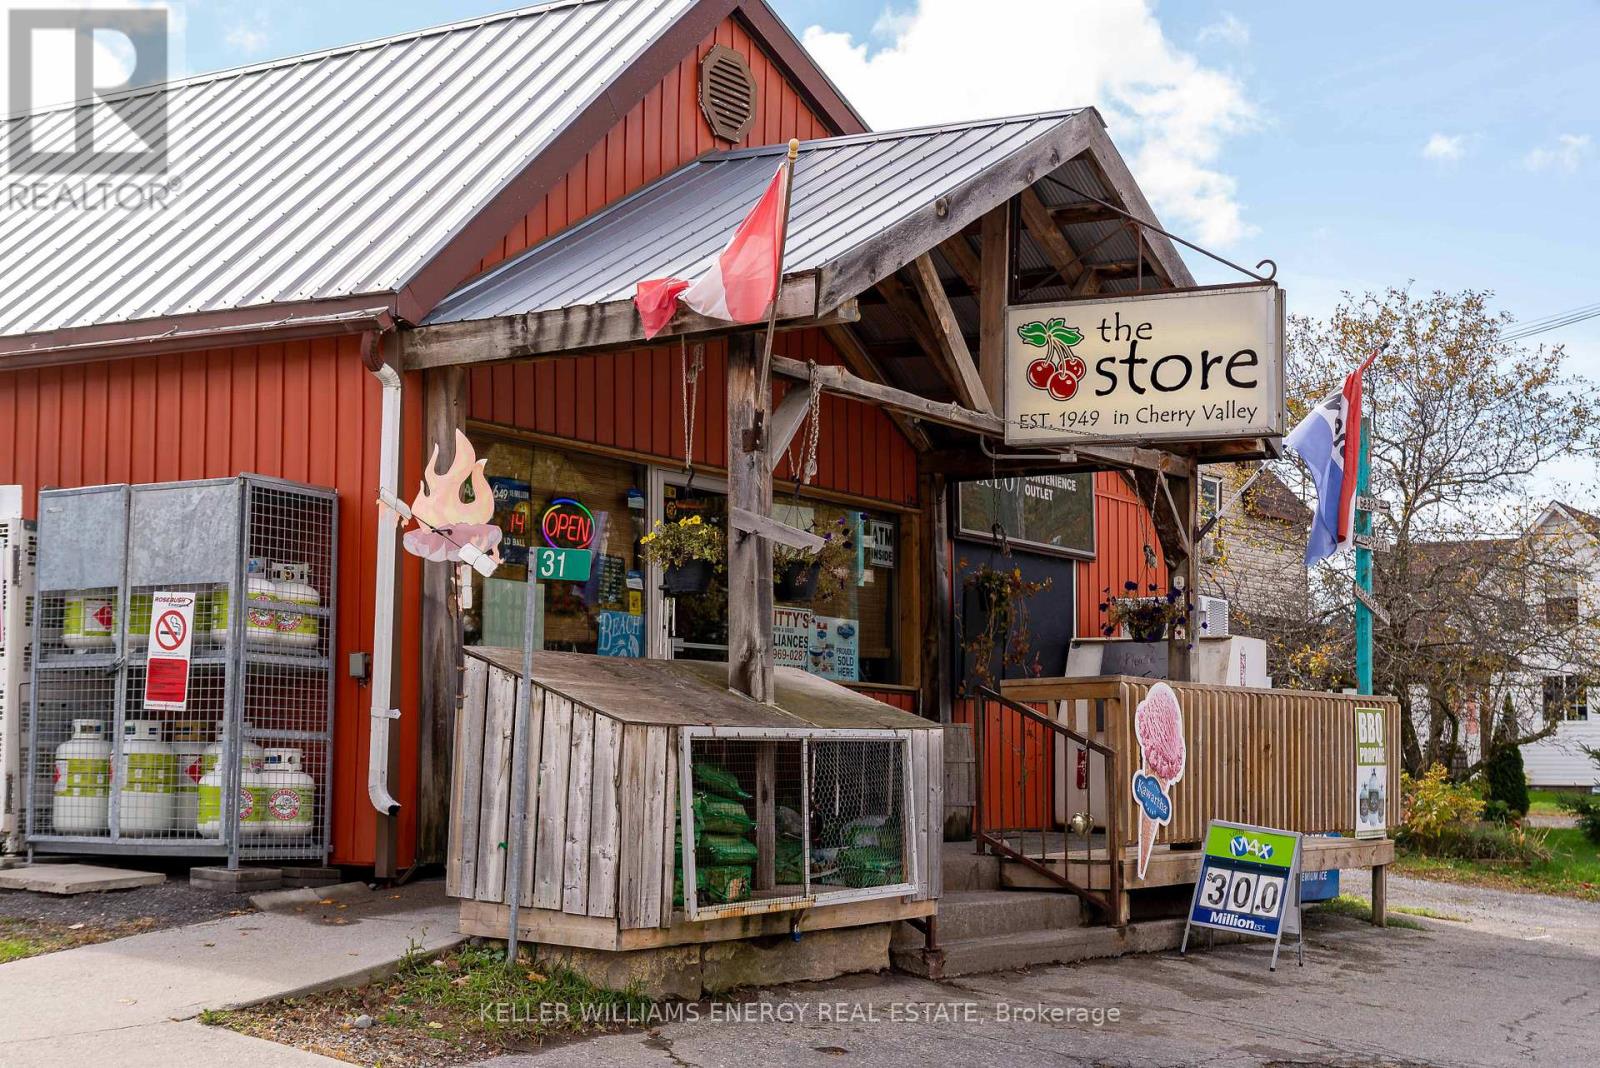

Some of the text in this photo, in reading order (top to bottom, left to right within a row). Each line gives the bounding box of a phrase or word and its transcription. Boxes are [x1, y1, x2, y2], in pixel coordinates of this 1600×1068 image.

[1097, 312, 1152, 342] the
[1095, 340, 1258, 396] store
[1019, 400, 1258, 429] EST. 1949 in Cherry Valley
[1025, 484, 1053, 501] OUTLET
[510, 513, 525, 534] 14
[545, 512, 591, 542] OPEN
[873, 525, 893, 546] ATM
[541, 550, 566, 577] 31
[773, 610, 809, 629] ITTY'S
[599, 612, 641, 650] BEACH
[773, 633, 809, 649] LIANCES
[837, 656, 854, 666] SOLD
[837, 667, 854, 678] HERE
[1358, 712, 1384, 747] BBQ
[1359, 747, 1385, 763] PROPANE
[1301, 871, 1328, 882] EMIUM ICE
[1209, 911, 1255, 930] Million
